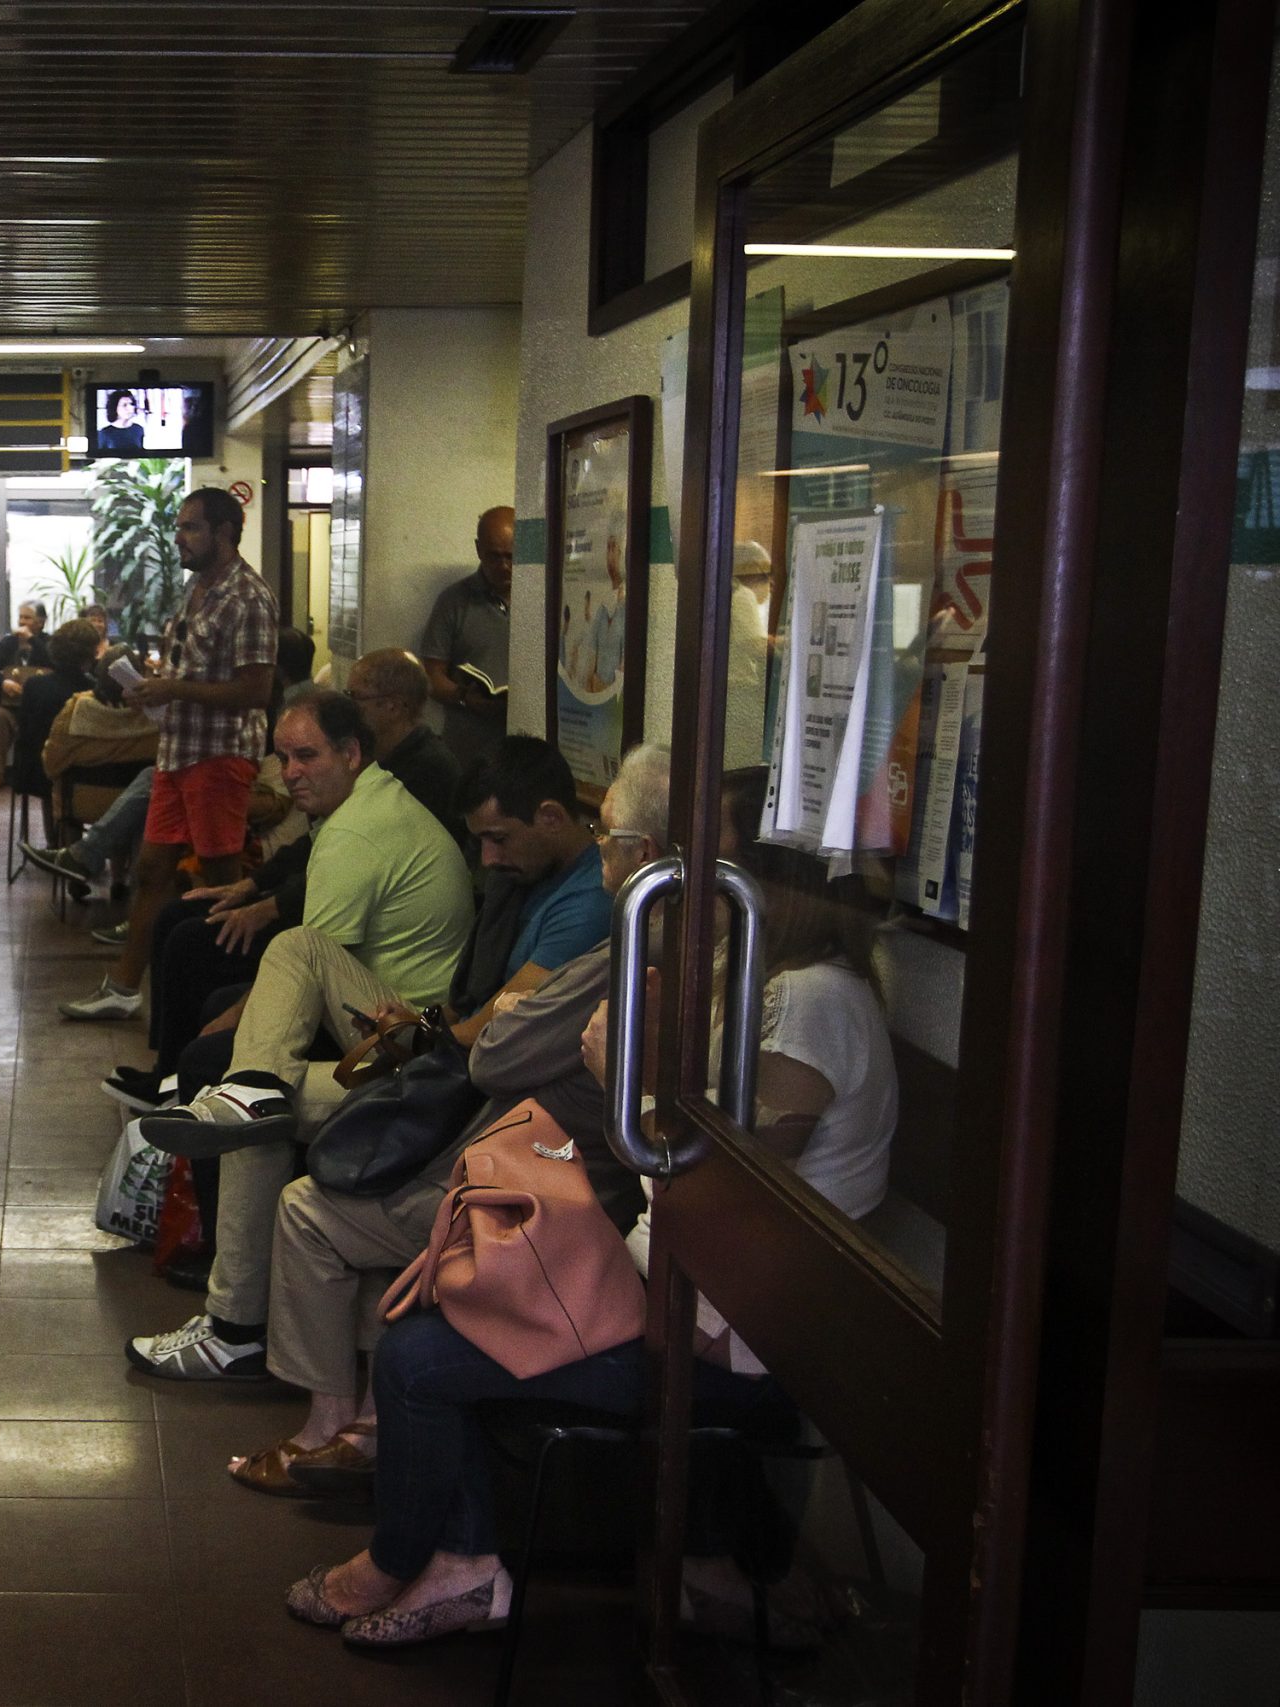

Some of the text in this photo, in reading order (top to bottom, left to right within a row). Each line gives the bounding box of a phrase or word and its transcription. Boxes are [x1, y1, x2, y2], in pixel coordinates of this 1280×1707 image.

[885, 377, 941, 396] DE ONCOLOGIA
[110, 1212, 157, 1240] MER
